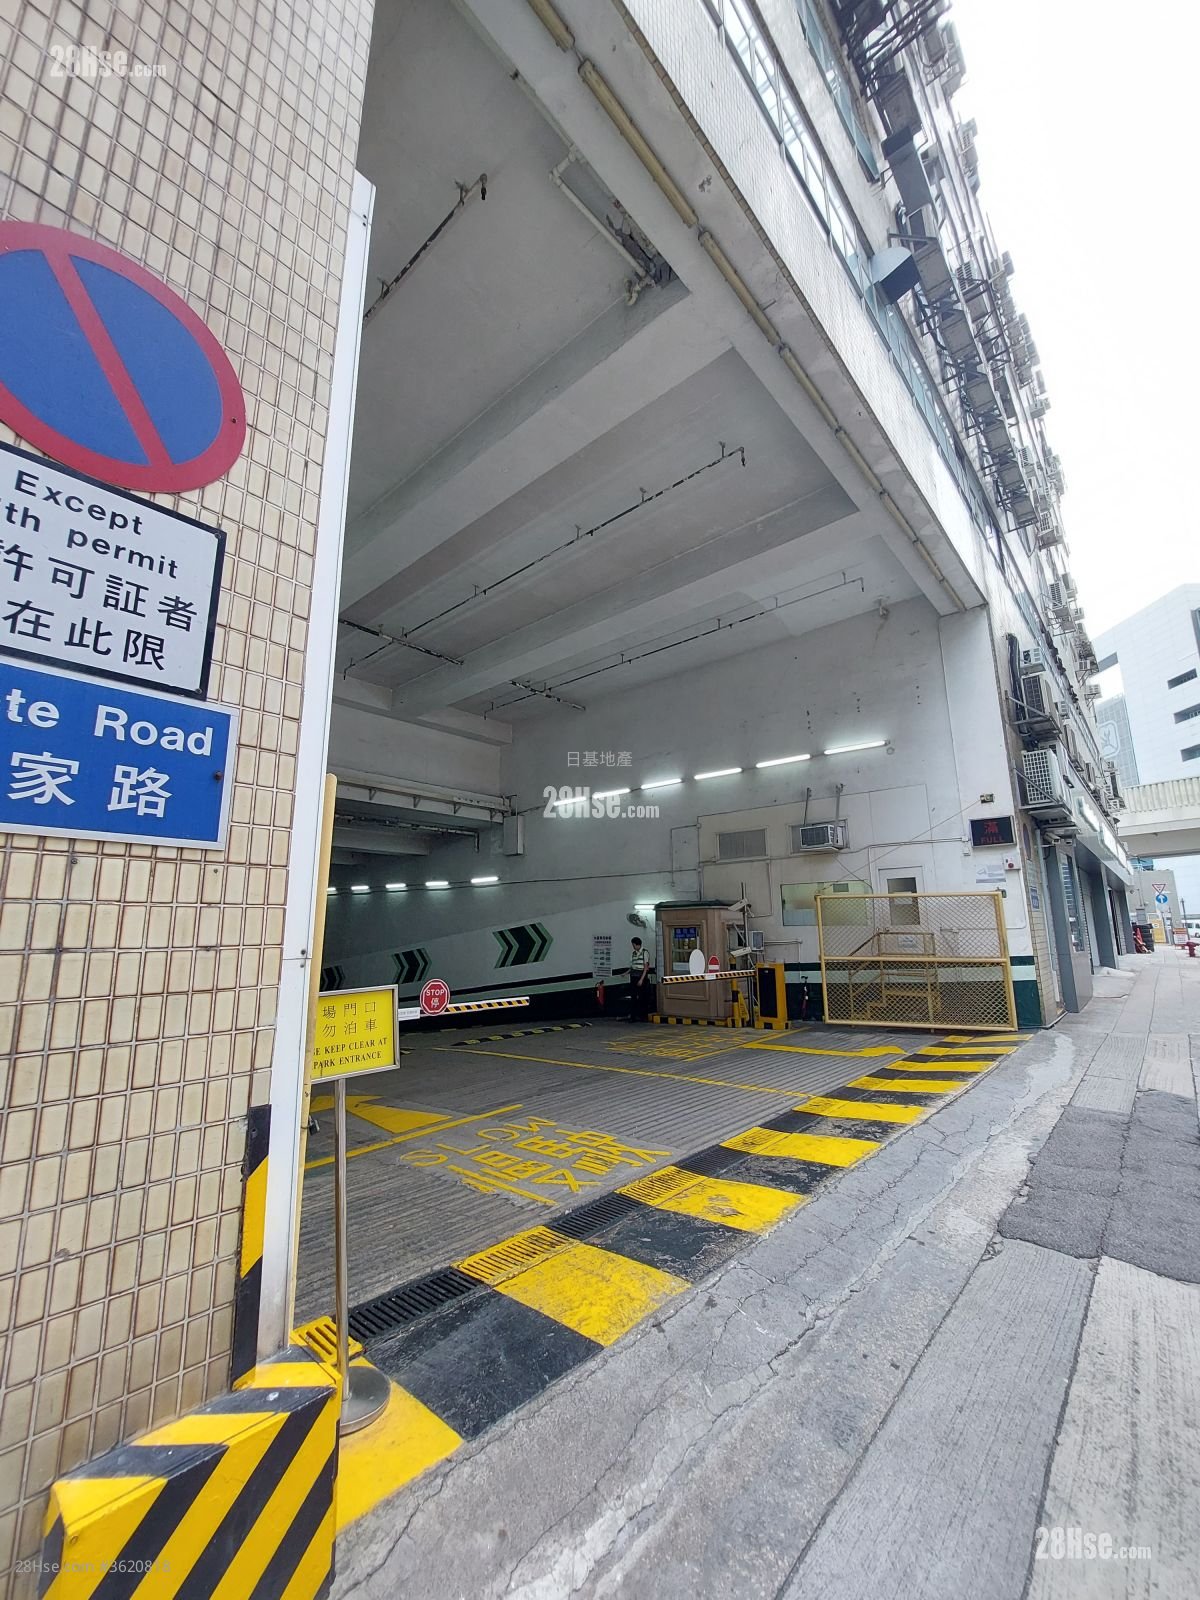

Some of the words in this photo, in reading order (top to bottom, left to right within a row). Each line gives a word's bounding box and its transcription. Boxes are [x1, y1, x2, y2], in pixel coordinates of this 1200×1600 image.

[14, 469, 143, 536] Except
[66, 528, 179, 580] permit
[1, 599, 165, 671] 在此限
[93, 704, 214, 757] Road
[7, 751, 173, 819] 家路
[322, 1001, 377, 1020] 場門口
[425, 989, 445, 997] STOP
[430, 997, 440, 1009] 停
[322, 1018, 379, 1039] 勿泊車
[324, 1043, 346, 1055] KEEP
[348, 1039, 375, 1051] CLEAR
[378, 1037, 388, 1046] AT
[313, 1058, 336, 1070] PARK
[339, 1050, 383, 1065] ENTRANCE
[400, 1115, 558, 1168] SLOW
